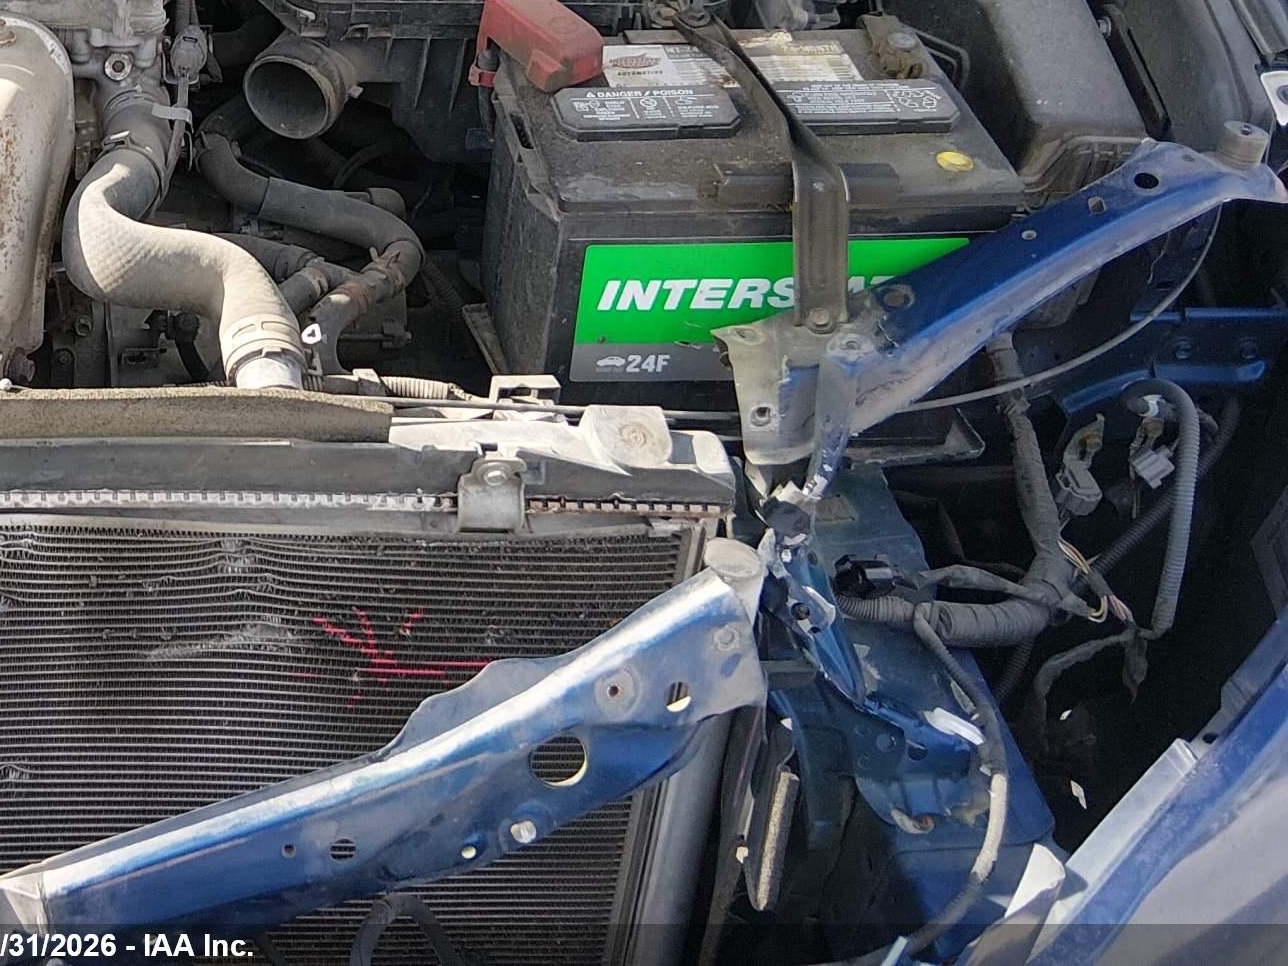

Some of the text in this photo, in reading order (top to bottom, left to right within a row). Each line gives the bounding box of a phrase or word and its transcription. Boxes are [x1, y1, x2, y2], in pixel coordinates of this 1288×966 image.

[596, 90, 643, 98] DANGER
[597, 278, 895, 311] INTERS
[625, 355, 671, 372] 24F
